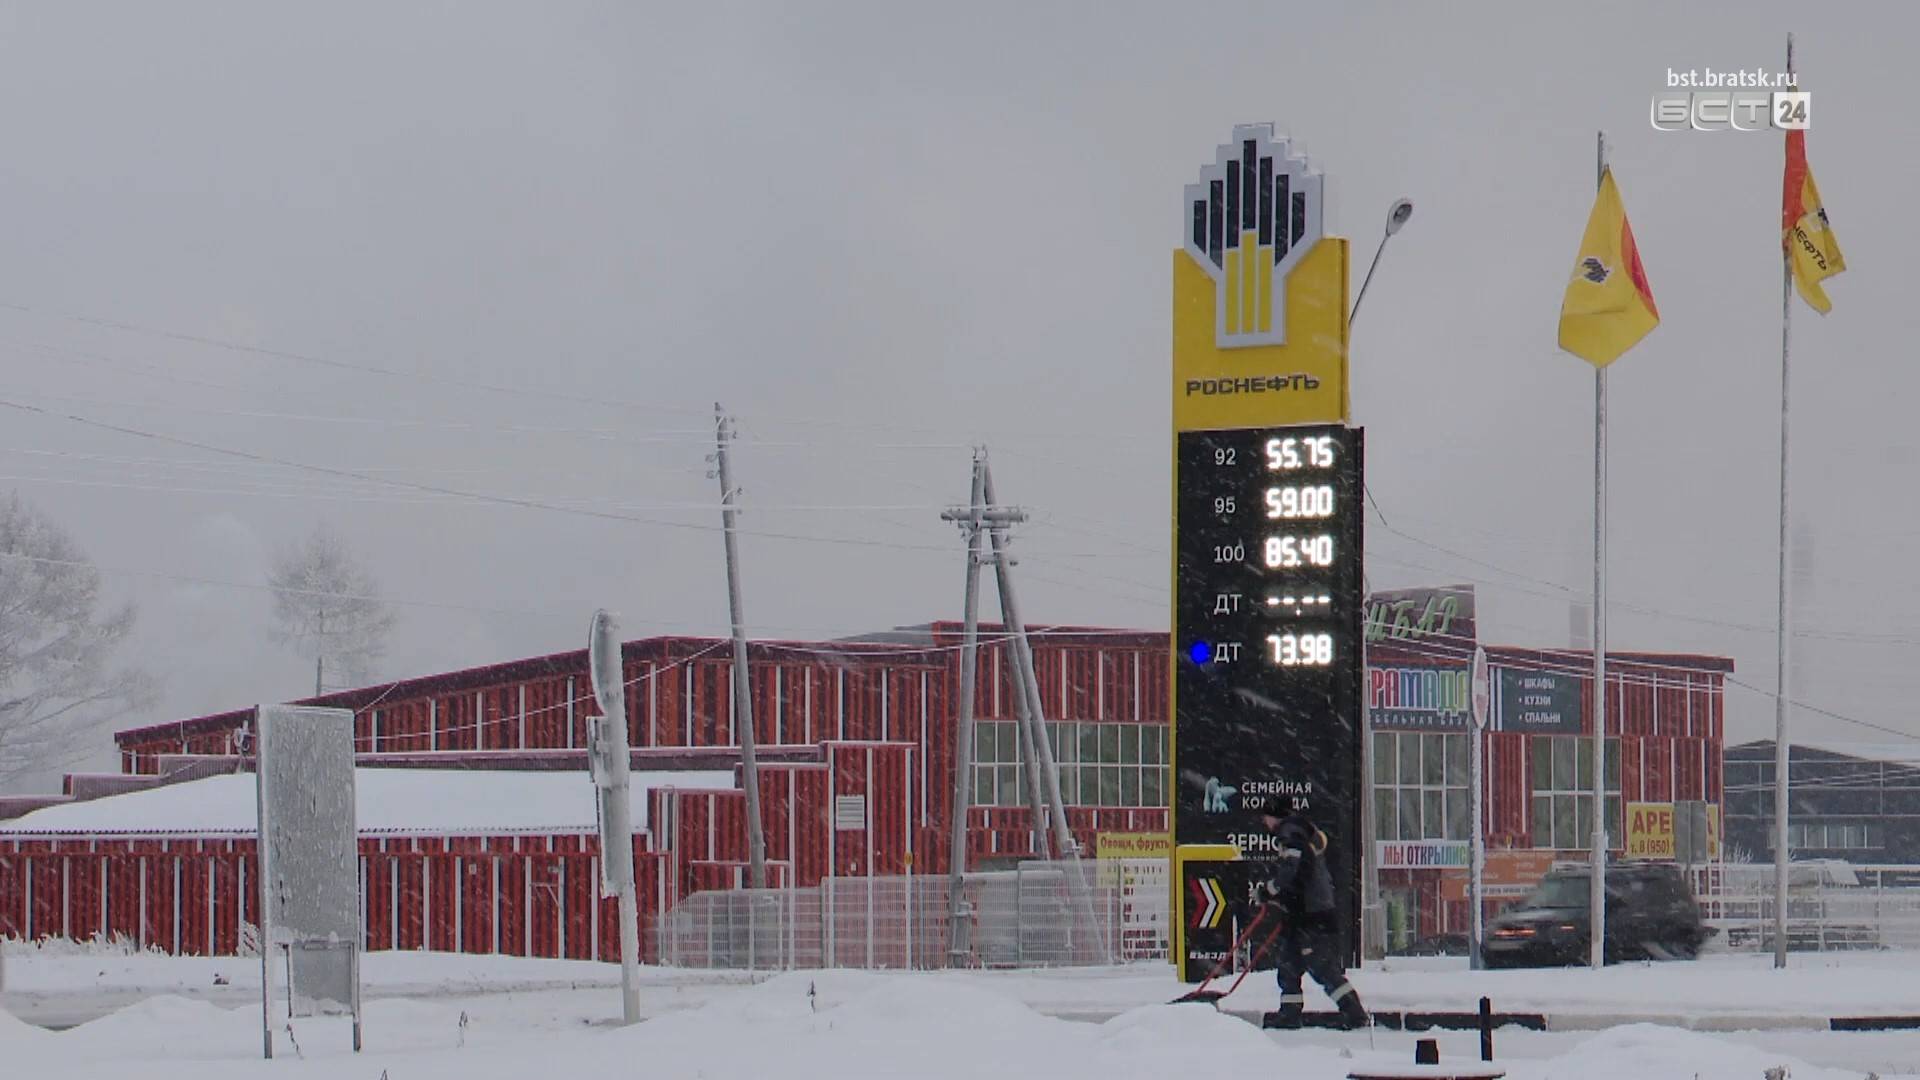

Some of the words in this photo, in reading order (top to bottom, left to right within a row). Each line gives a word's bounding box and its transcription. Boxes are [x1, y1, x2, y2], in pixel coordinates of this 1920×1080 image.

[1186, 374, 1320, 397] РОСНЕФТЬ
[1214, 449, 1236, 466] 92
[1265, 437, 1334, 469] 55.75
[1214, 497, 1236, 514] 95
[1265, 486, 1334, 519] 59.00
[1213, 546, 1245, 562] 100
[1265, 536, 1333, 567] 85.40
[1213, 595, 1242, 616] ДТ
[1213, 643, 1242, 664] ДТ
[1266, 634, 1333, 665] 73.98
[1368, 667, 1468, 717] РАМАДА
[1524, 695, 1551, 706] КУХНИ
[1368, 713, 1433, 725] БЕЛЬНАЯ
[1524, 711, 1561, 723] СПАЛЬНИ
[1241, 780, 1313, 794] СЕМЕЙНАЯ
[1383, 845, 1403, 865] МЫ
